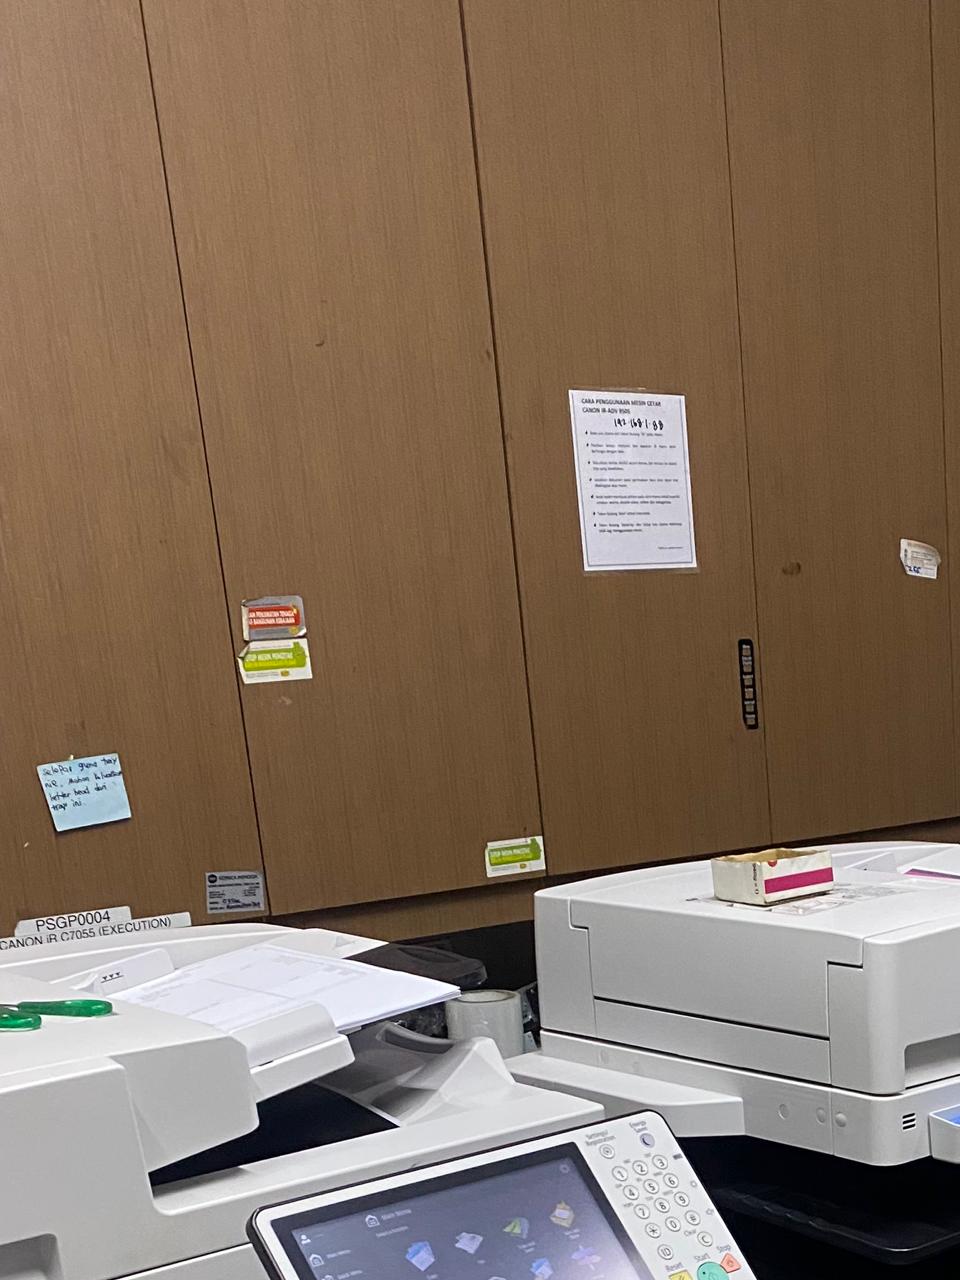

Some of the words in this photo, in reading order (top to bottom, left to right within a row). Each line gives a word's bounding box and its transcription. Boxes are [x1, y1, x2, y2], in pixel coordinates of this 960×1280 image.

[36, 910, 111, 932] PSGP0004
[0, 935, 43, 950] CANON
[60, 928, 96, 941] C7055
[99, 917, 172, 936] (EXECUTION)
[717, 1244, 732, 1254] Stop
[694, 1253, 711, 1262] Start
[665, 1262, 684, 1272] Reset
